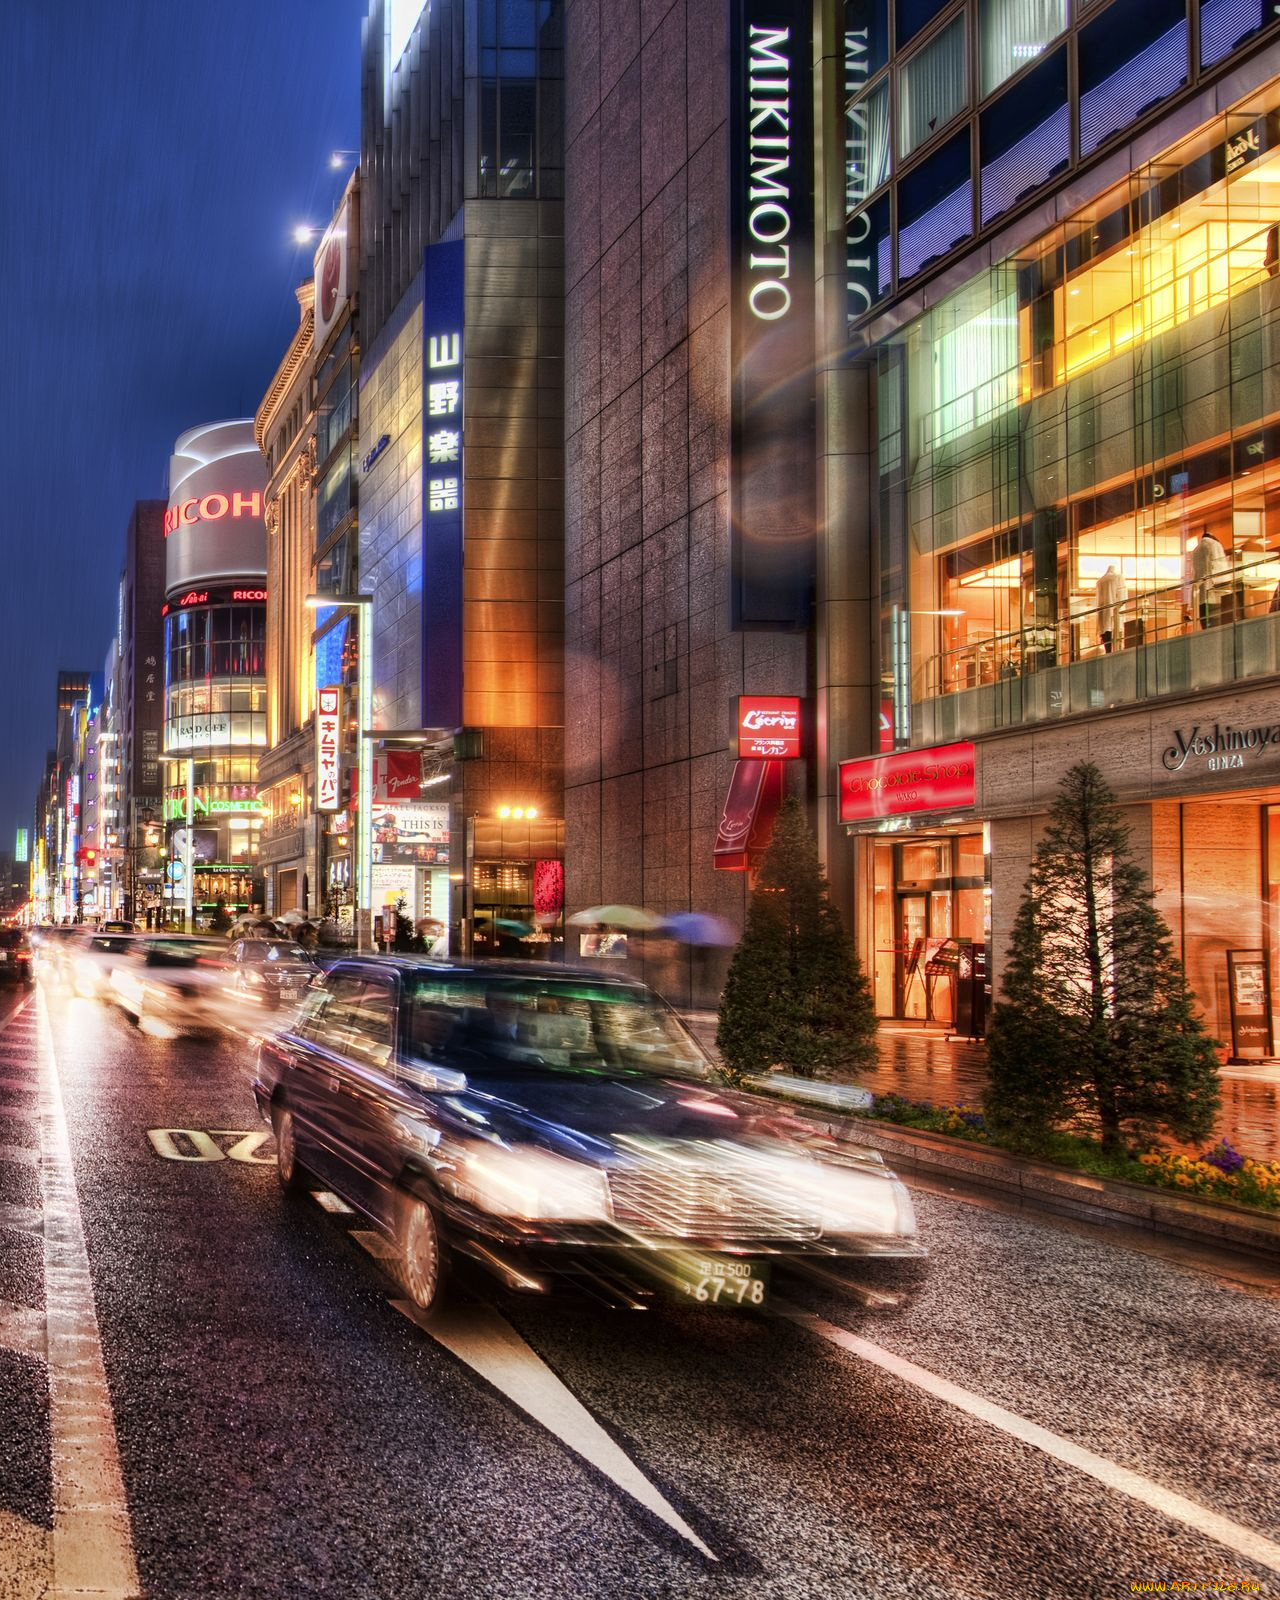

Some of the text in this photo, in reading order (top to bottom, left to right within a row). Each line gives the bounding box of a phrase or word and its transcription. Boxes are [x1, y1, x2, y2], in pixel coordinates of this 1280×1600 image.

[749, 24, 791, 321] MIKIMOTO
[428, 333, 460, 511] 山野楽器
[164, 492, 260, 538] RICOH
[1162, 723, 1280, 771] Yoshinoya
[322, 721, 337, 803] キムラヤのパン
[1208, 755, 1244, 770] GINZA
[388, 774, 419, 792] Fender
[850, 762, 969, 792] Chocolate Shop
[896, 790, 917, 801] WAKO
[401, 820, 443, 829] THIS IS
[727, 1263, 751, 1277] 500
[696, 1278, 765, 1304] 67-78
